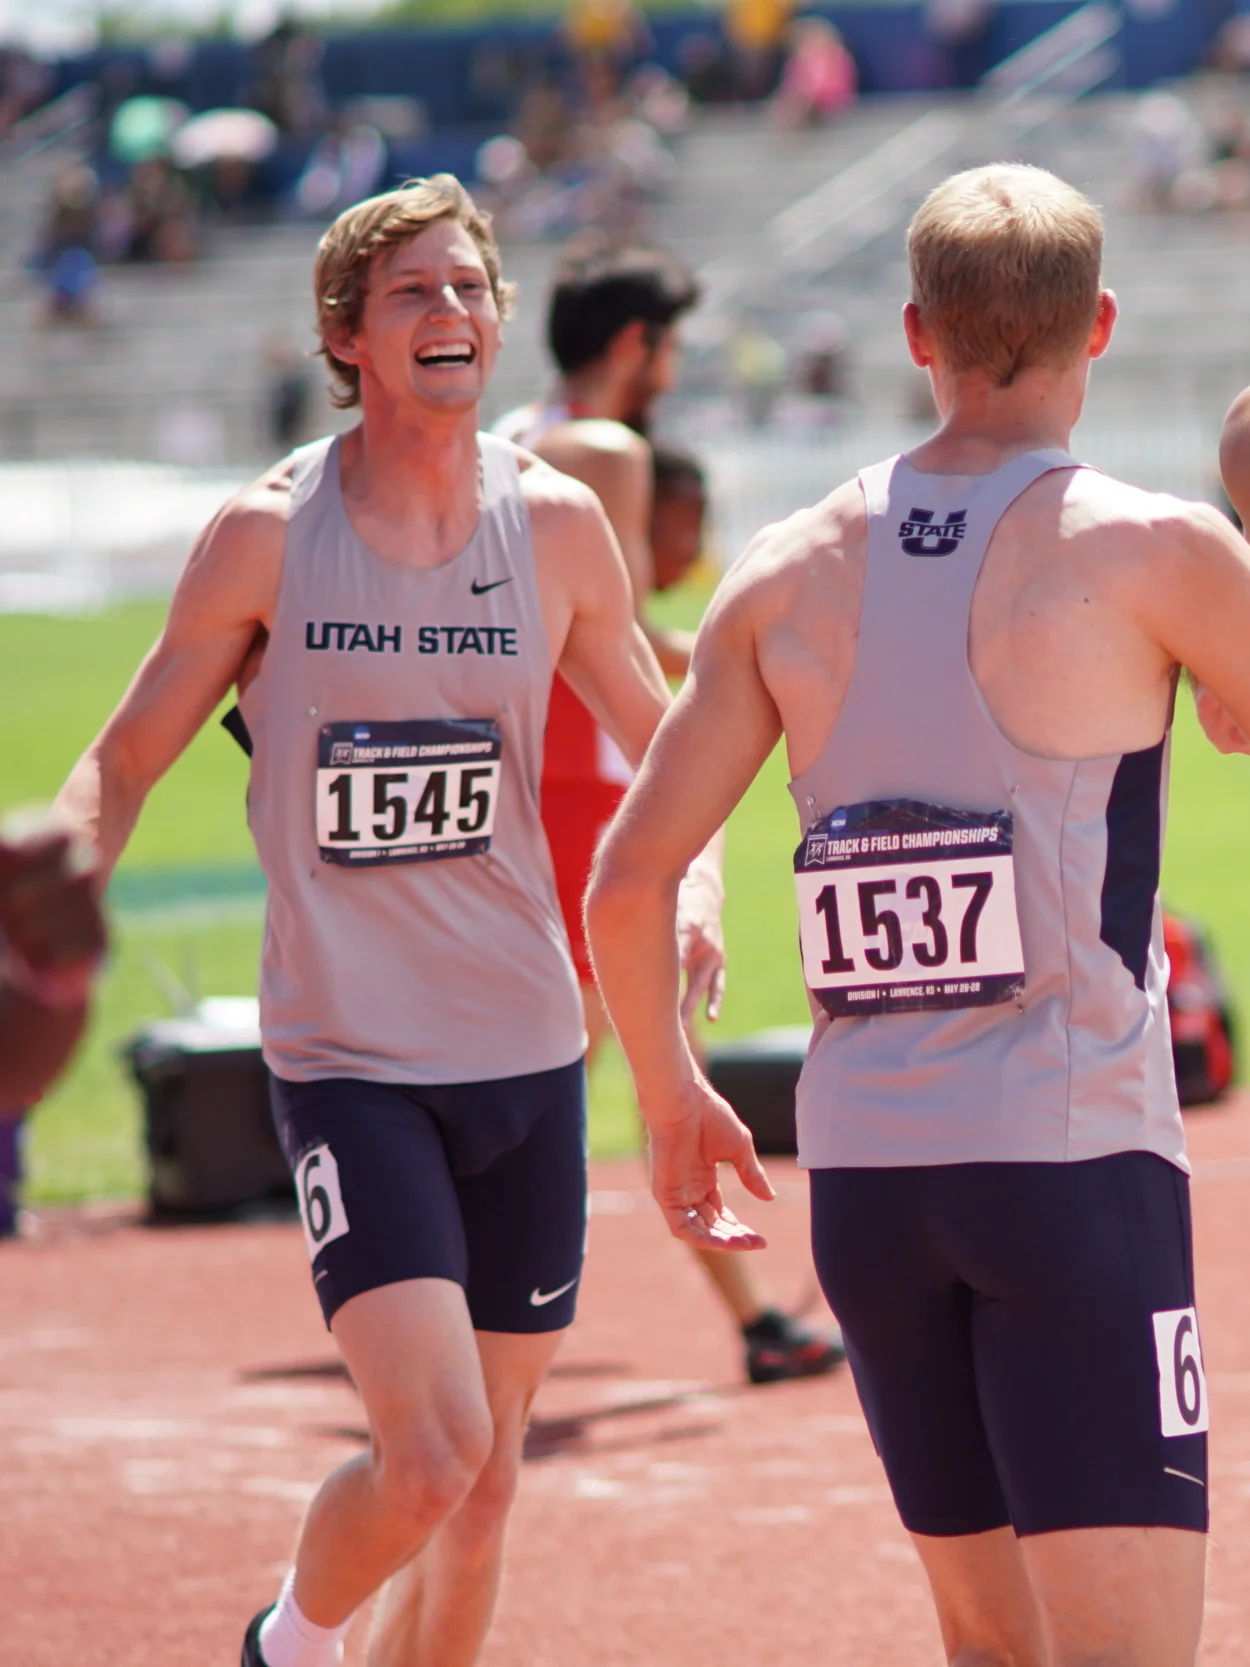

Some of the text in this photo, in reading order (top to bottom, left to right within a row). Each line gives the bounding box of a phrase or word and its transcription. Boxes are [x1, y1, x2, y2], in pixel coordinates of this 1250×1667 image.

[898, 521, 967, 539] STATE
[305, 621, 519, 656] UTAH STATE
[352, 745, 384, 759] TRACK
[392, 744, 418, 758] FIELD
[418, 741, 493, 757] CHAMPIONSHIPS
[328, 767, 494, 842] 1545
[827, 837, 860, 855] TRACK
[860, 837, 870, 853] &
[870, 835, 900, 852] FIELD
[901, 827, 999, 849] CHAMPIONSHIPS
[815, 871, 994, 975] 1537
[847, 991, 876, 1002] DIVISION
[925, 985, 935, 996] KS
[943, 983, 959, 995] MAY
[303, 1153, 332, 1243] 6
[1173, 1315, 1201, 1426] 6
